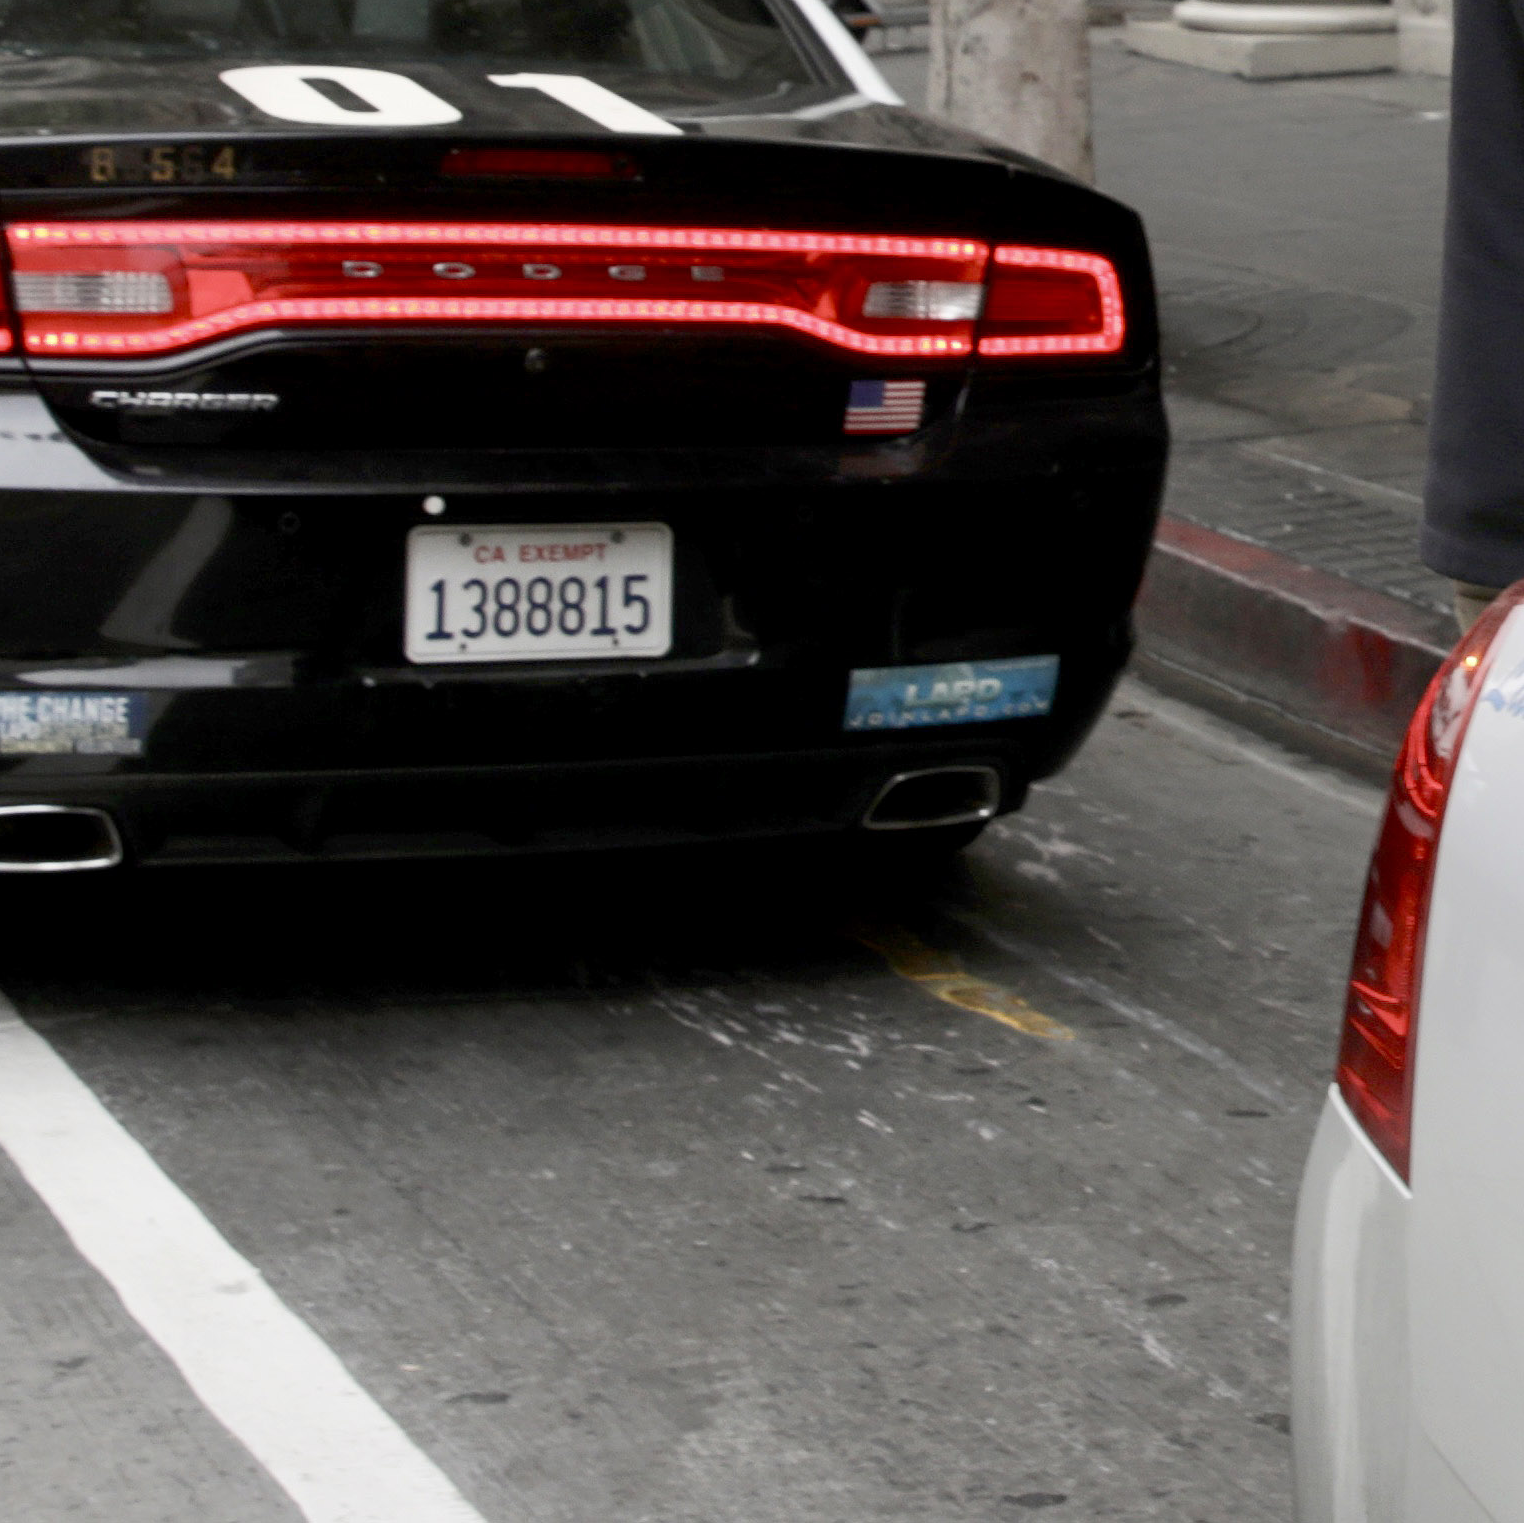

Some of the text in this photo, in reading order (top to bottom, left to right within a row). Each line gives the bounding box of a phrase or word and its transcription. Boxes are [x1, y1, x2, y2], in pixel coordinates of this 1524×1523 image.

[341, 259, 726, 283] DODGE
[89, 389, 281, 411] CHARGER
[473, 542, 608, 564] CA EXEMPT
[425, 574, 651, 641] 1388815
[903, 676, 1003, 707] LAPD
[36, 696, 130, 724] CHANGE
